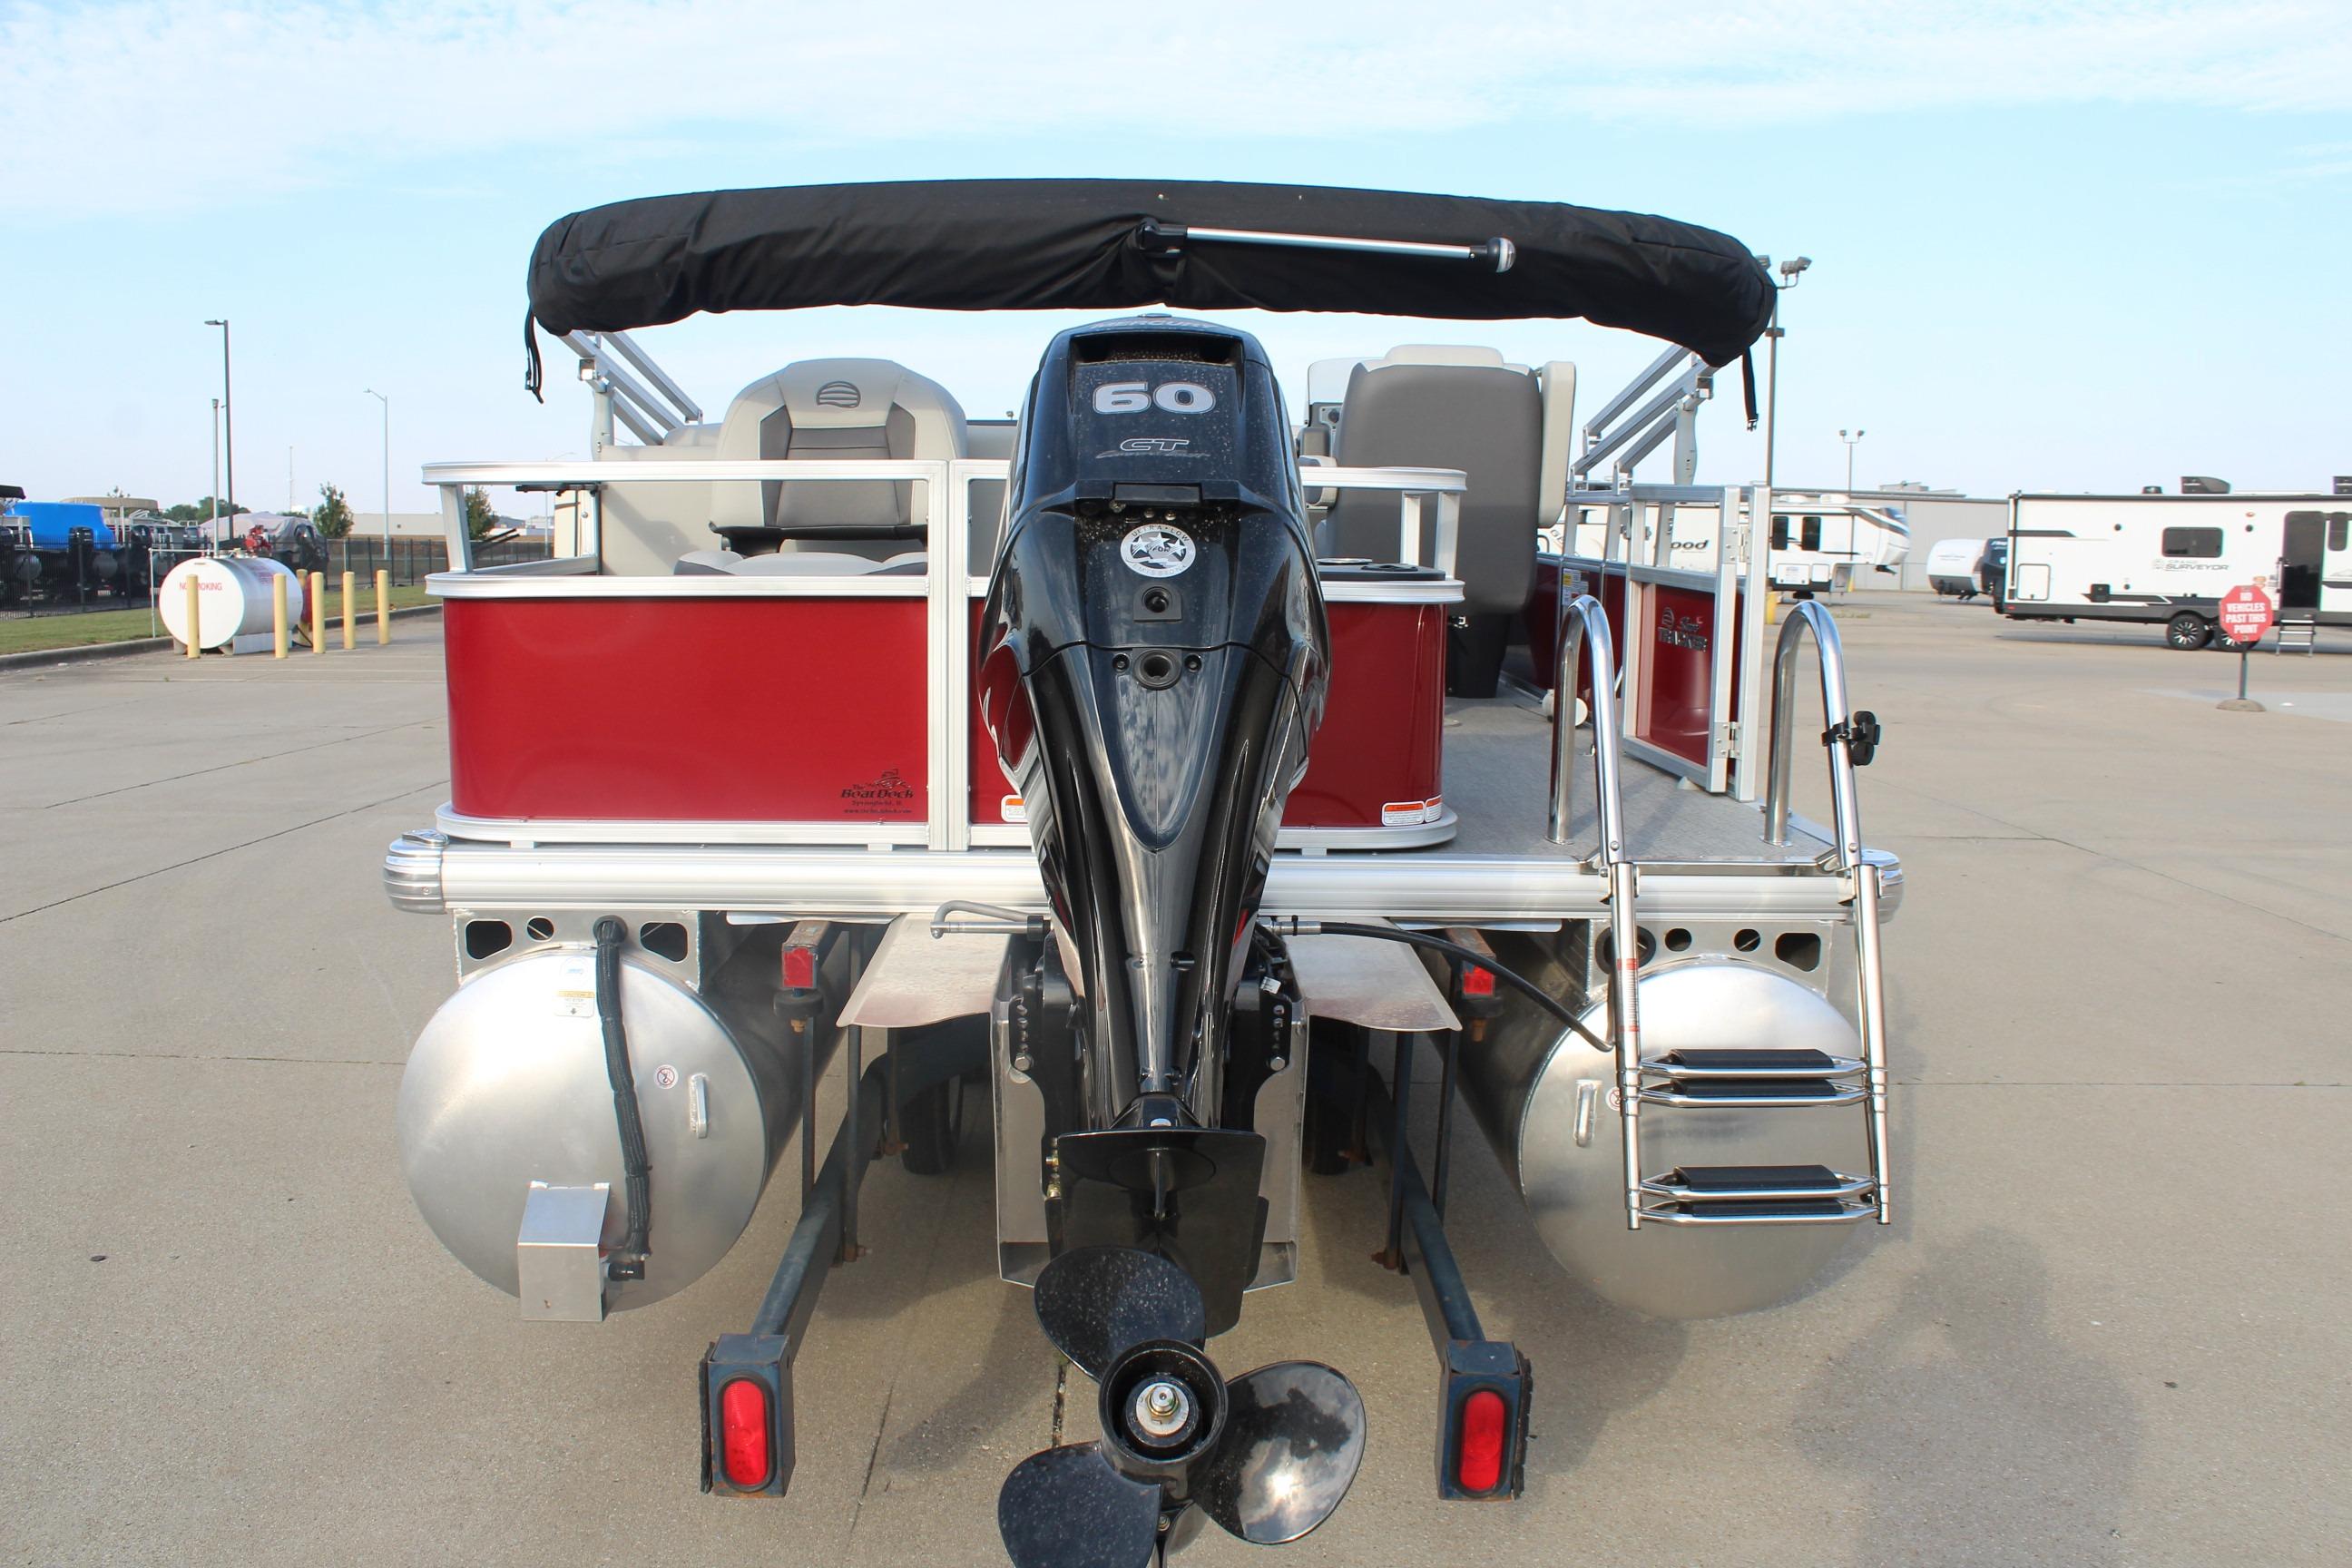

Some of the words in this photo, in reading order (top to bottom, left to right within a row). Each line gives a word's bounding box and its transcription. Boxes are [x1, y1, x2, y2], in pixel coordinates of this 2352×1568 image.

[1093, 381, 1217, 414] 60
[1132, 524, 1162, 537] ULTRA
[1171, 528, 1190, 542] LOW
[1671, 540, 1709, 549] ood
[2226, 603, 2266, 612] VEHICLES
[2225, 613, 2247, 623] PAST
[2248, 612, 2267, 622] THIS
[2233, 624, 2259, 634] POINT
[841, 789, 874, 799] Boat
[877, 789, 914, 799] Dock
